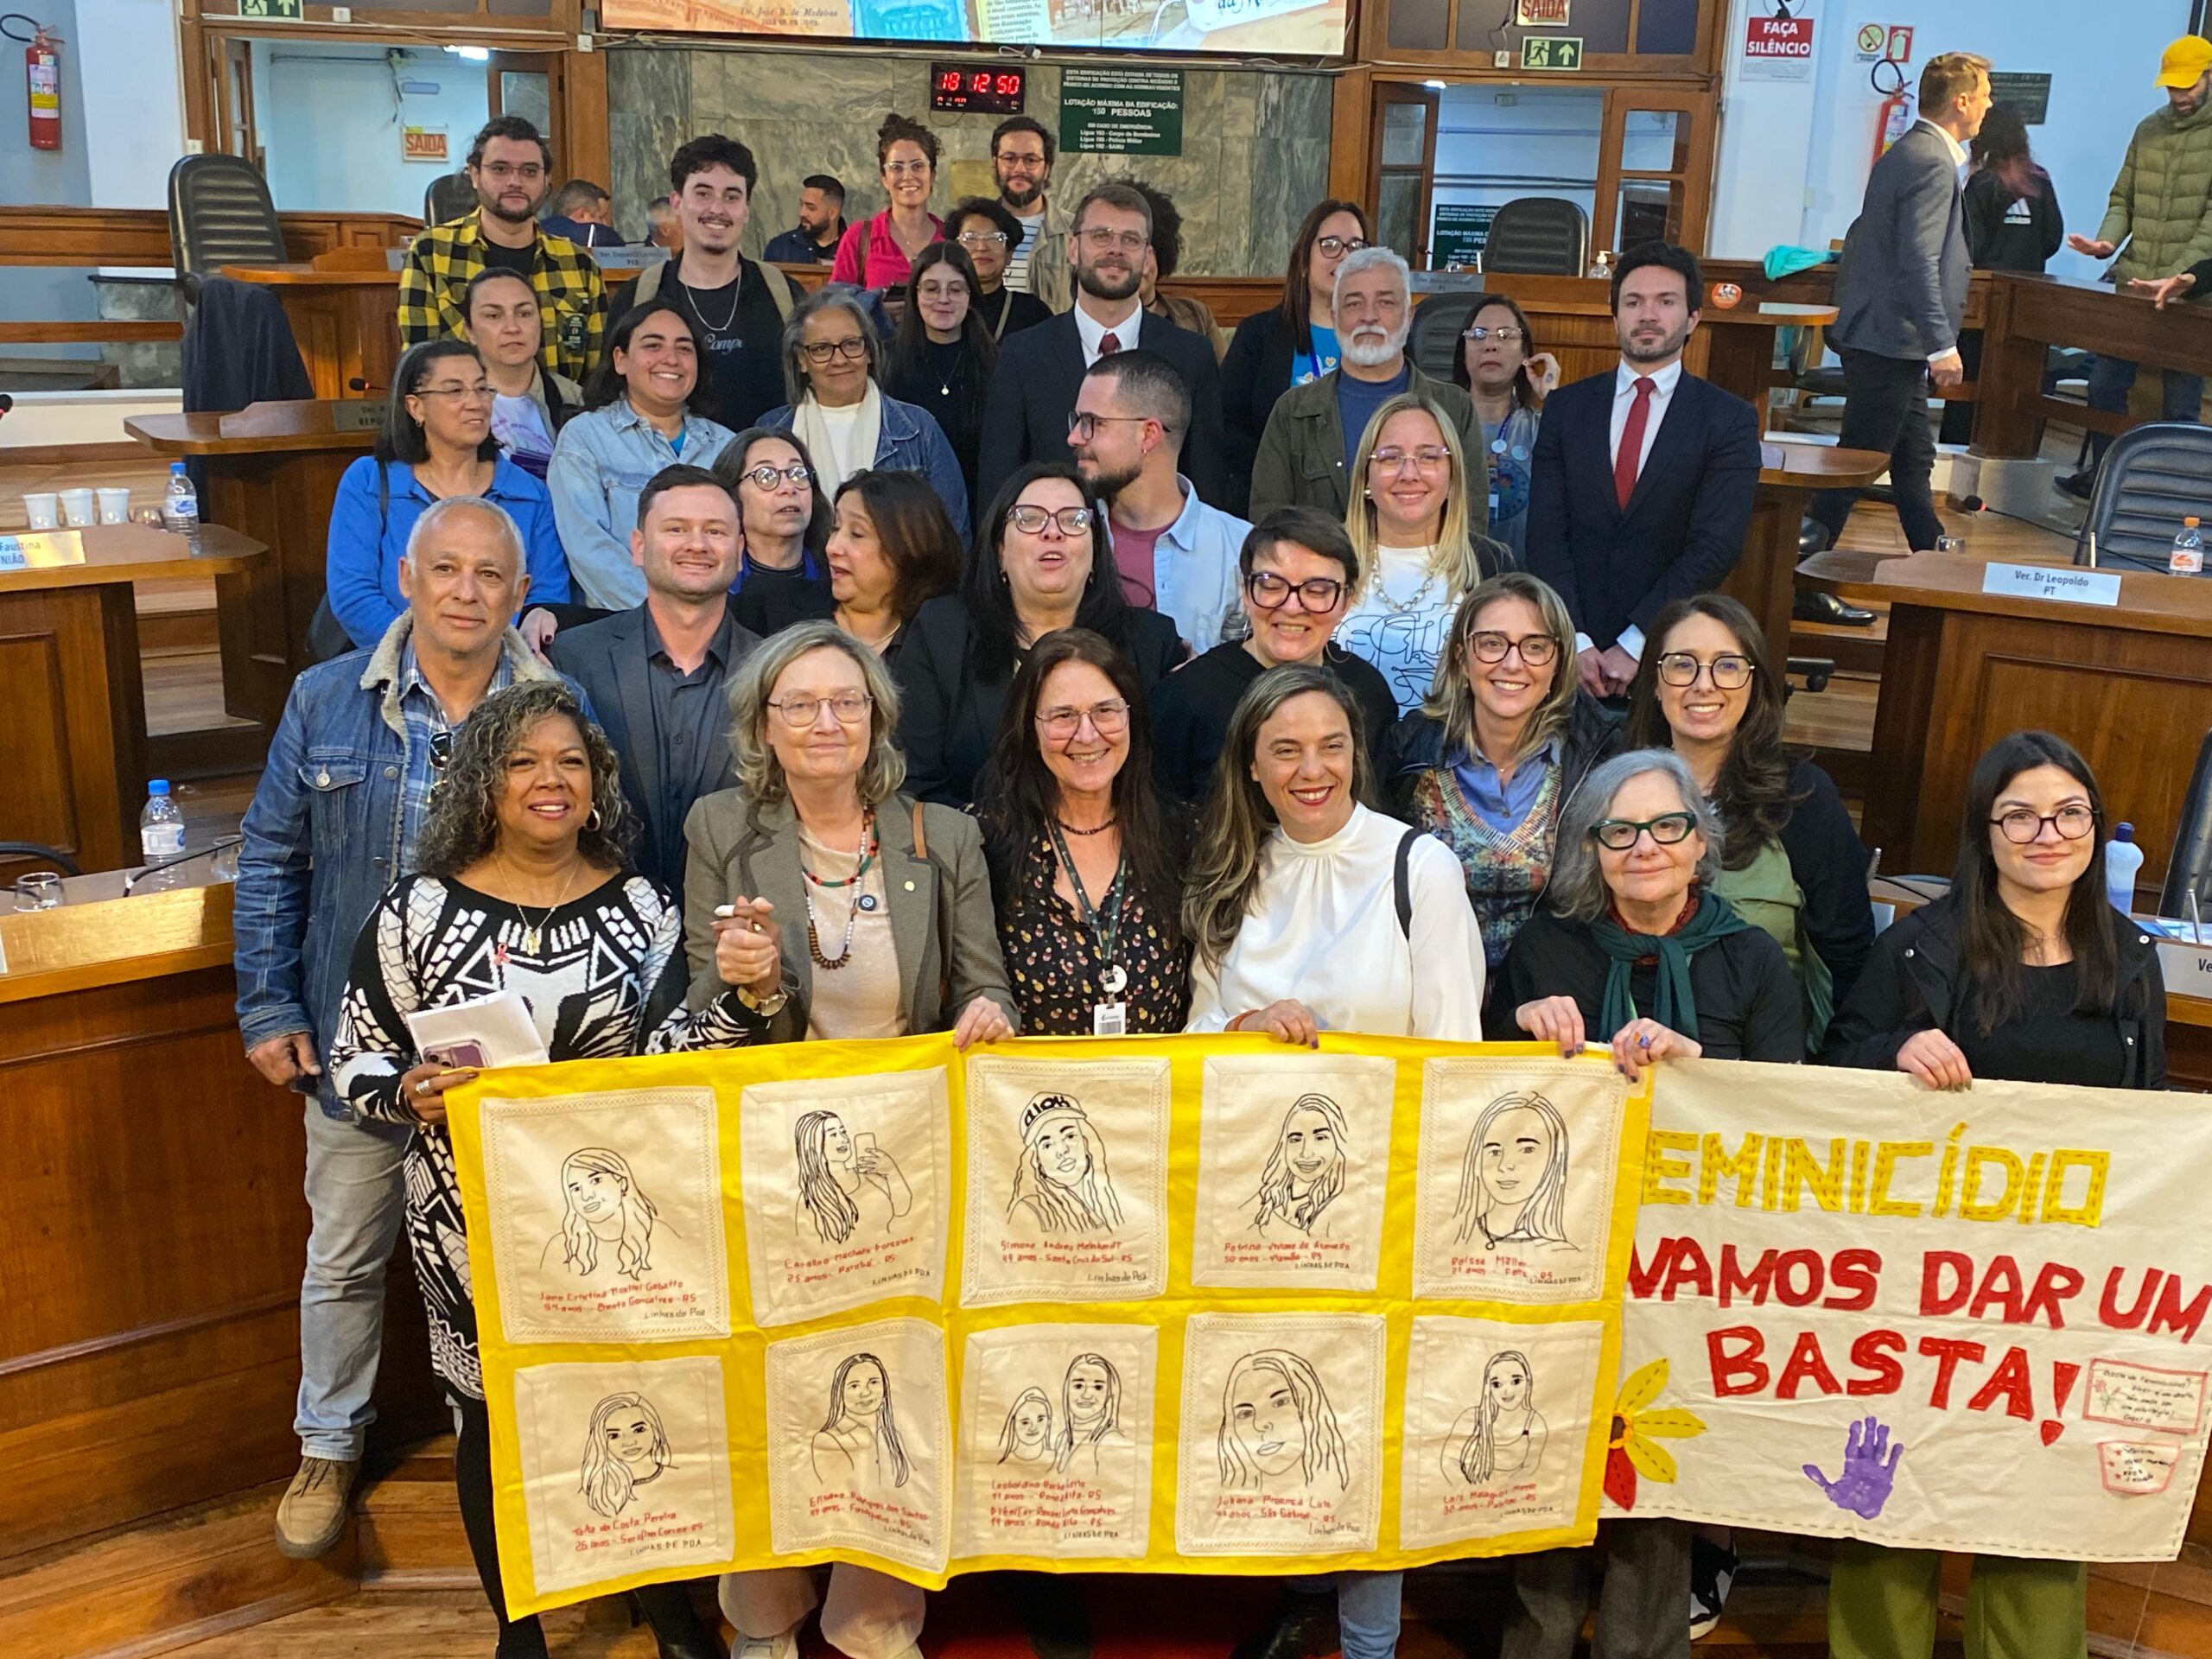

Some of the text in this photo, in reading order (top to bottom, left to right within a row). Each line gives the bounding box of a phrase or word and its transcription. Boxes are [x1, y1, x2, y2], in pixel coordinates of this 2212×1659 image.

[1764, 22, 1798, 38] FAÇA
[1747, 38, 1810, 54] SILÊNCIO
[943, 72, 1020, 94] 18 12 50
[1064, 98, 1096, 106] LOTAÇÃO
[1136, 101, 1179, 110] EDIFICAÇÃO:
[1111, 108, 1152, 118] PESSOAS
[0, 542, 41, 551] Faustina
[0, 552, 25, 565] NIÃO
[2015, 570, 2089, 587] Ver. Dr Leopoldo
[2044, 586, 2056, 595] PT
[2198, 957, 2212, 973] Ve
[1642, 1122, 2110, 1228] EMINICÍDIO
[1628, 1236, 2212, 1344] VAMOS DAR UM
[1707, 1325, 2081, 1446] BASTA!
[613, 1516, 639, 1530] Costa
